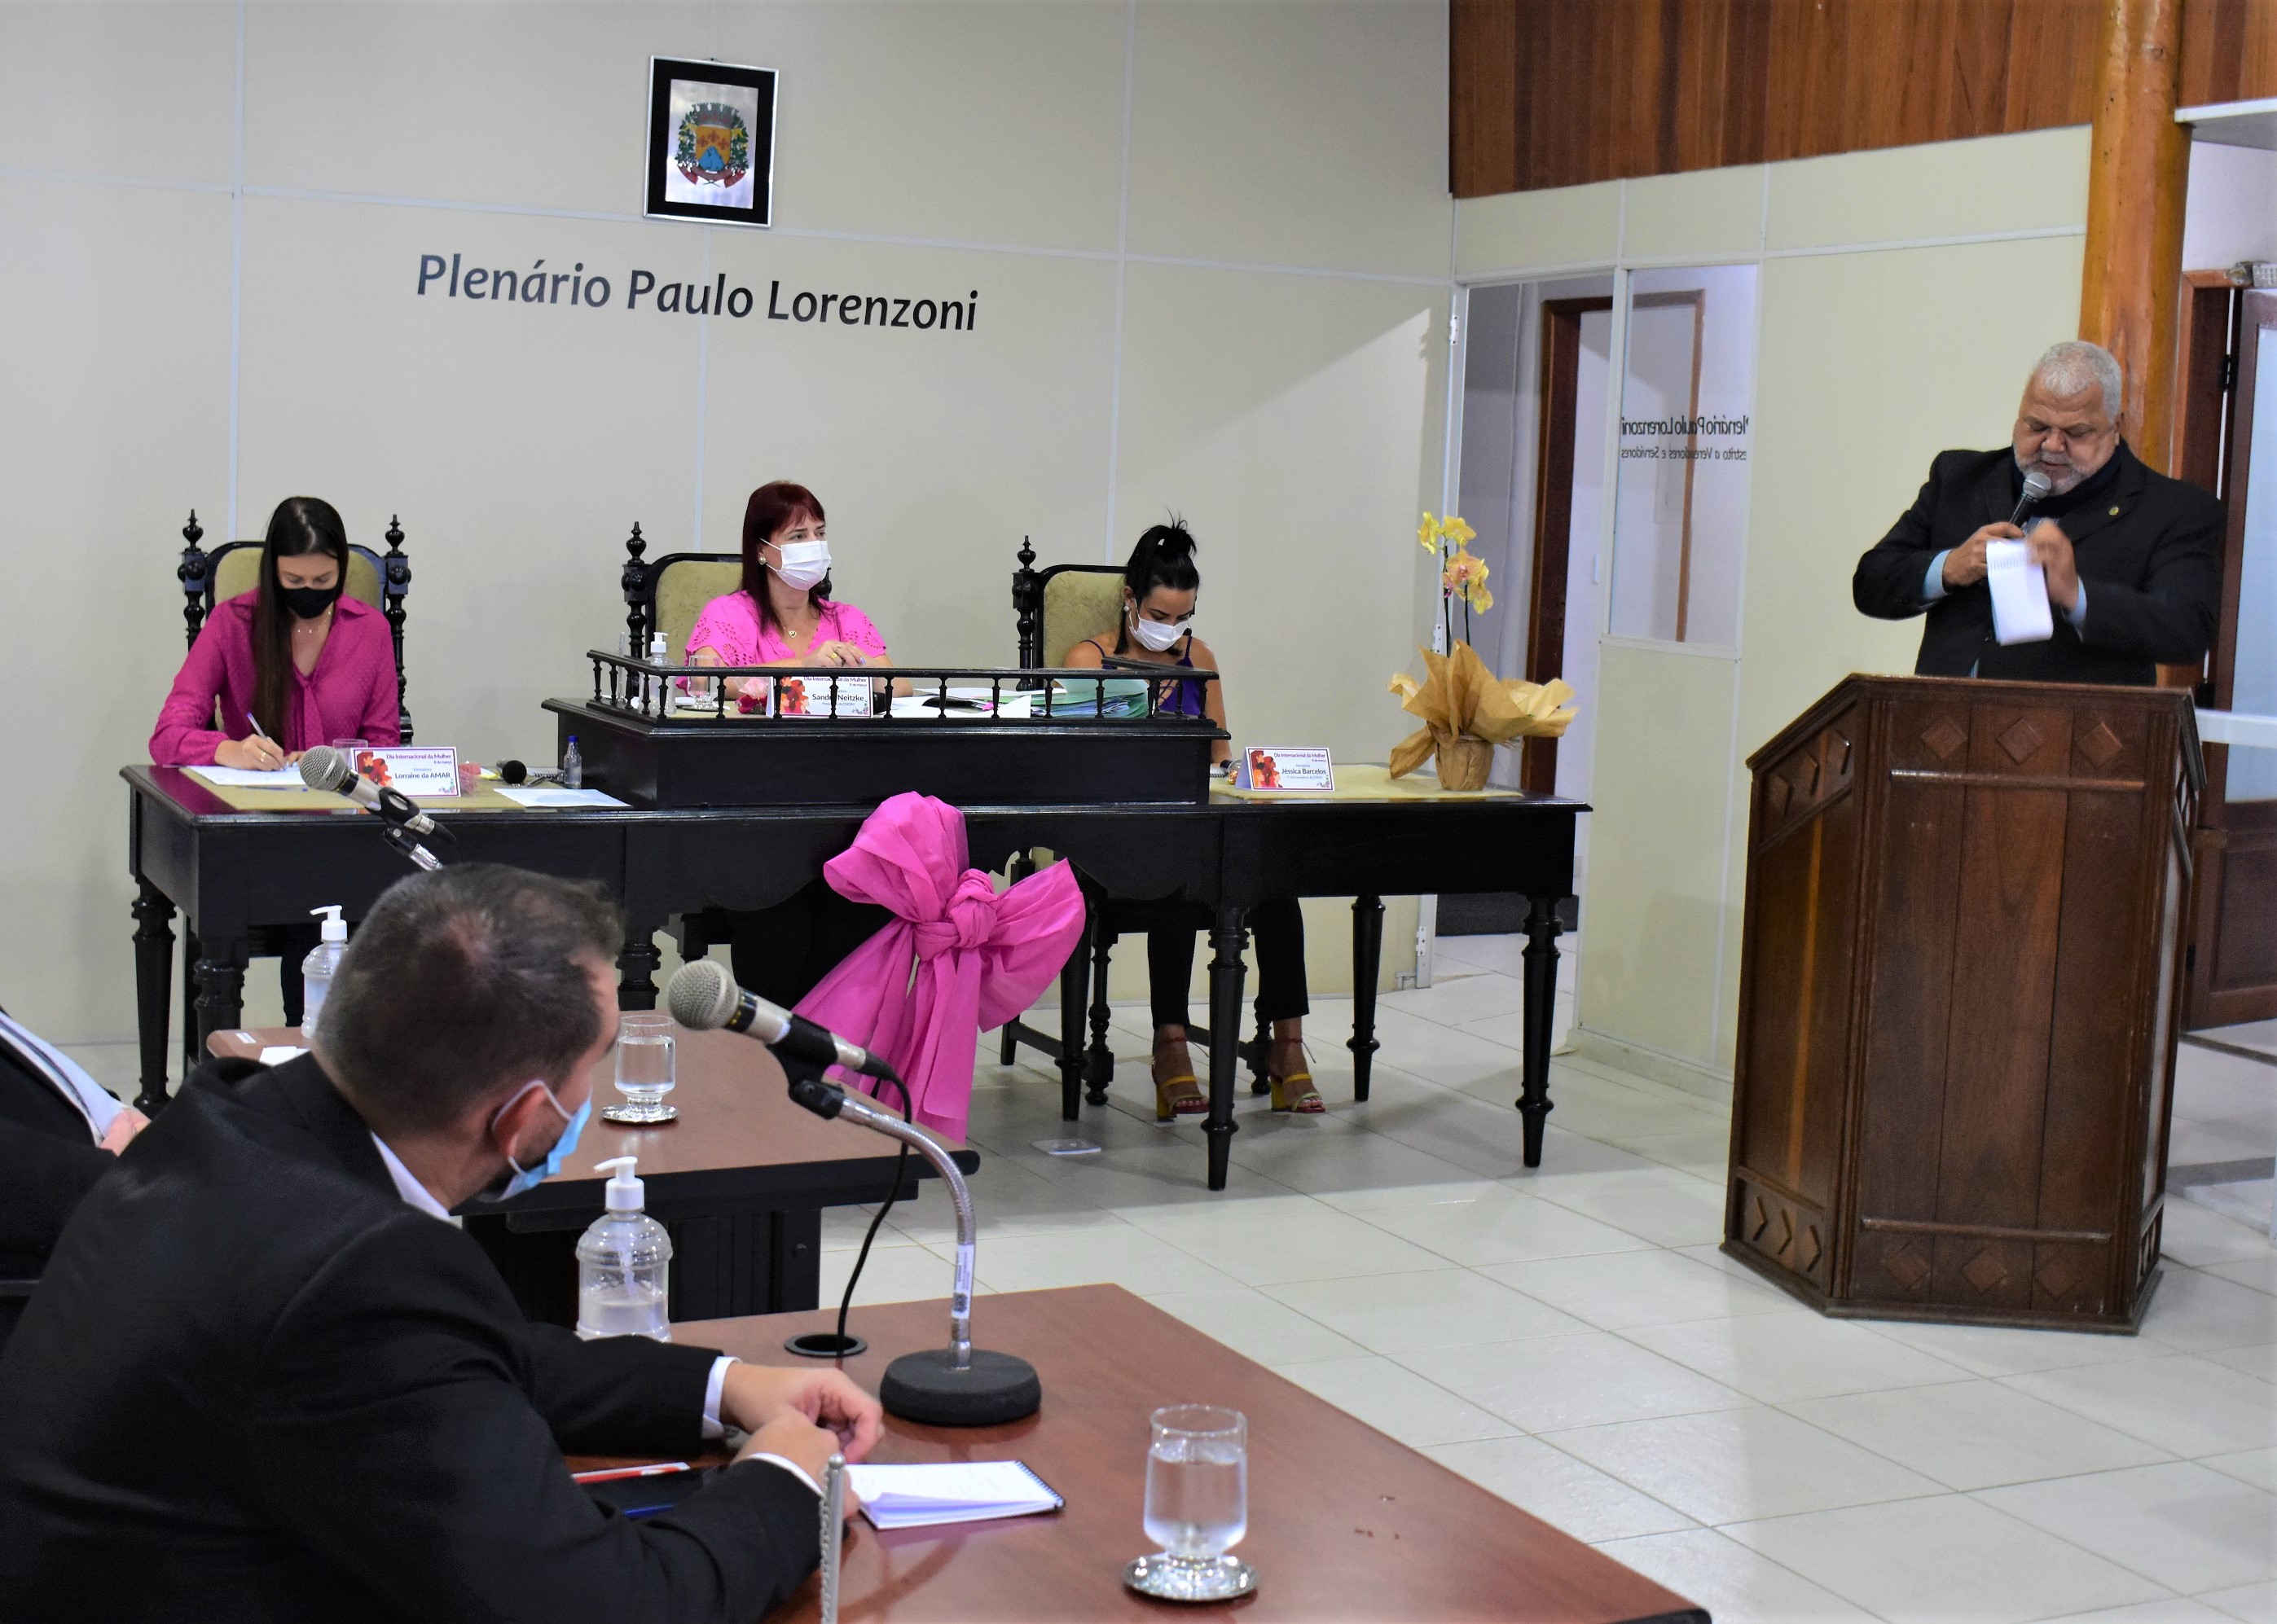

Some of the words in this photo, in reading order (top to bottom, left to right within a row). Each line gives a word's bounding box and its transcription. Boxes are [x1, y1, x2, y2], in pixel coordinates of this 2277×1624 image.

[416, 253, 612, 308] Plenário
[626, 269, 754, 318] Paulo
[767, 279, 979, 331] Lorenzoni
